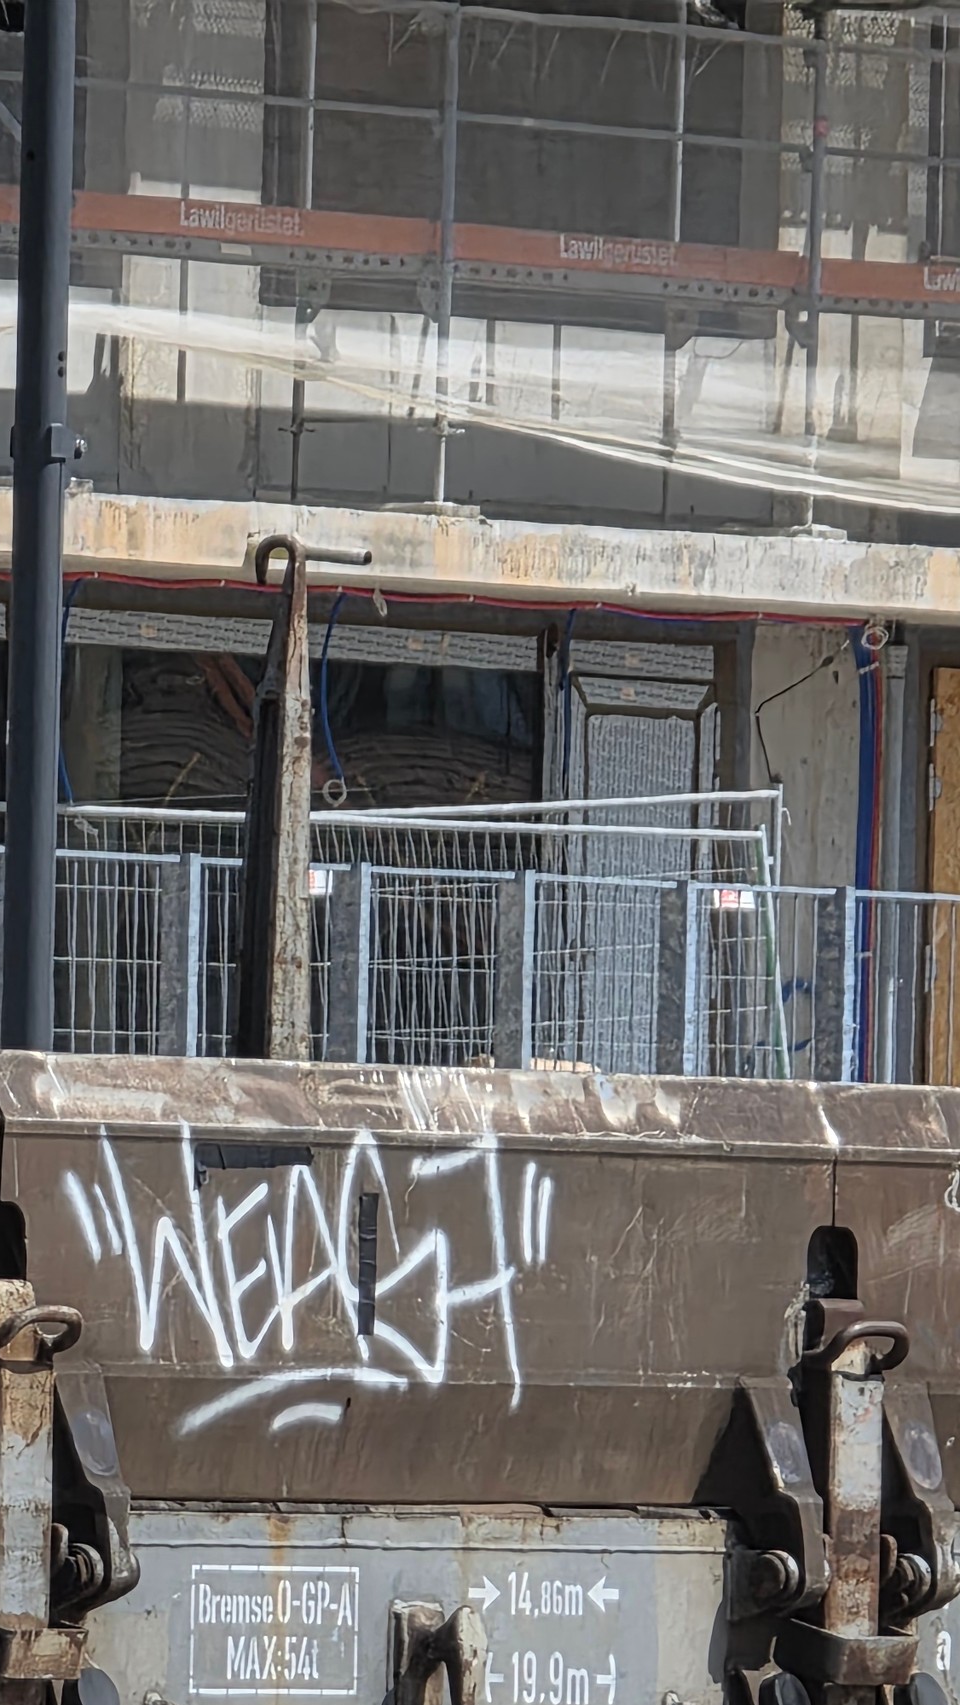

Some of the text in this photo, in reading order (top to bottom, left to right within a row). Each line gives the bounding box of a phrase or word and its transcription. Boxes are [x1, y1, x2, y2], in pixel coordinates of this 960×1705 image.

[198, 1583, 274, 1624] Bremse
[507, 1571, 583, 1618] 14,86m
[511, 1650, 590, 1705] 19,9m
